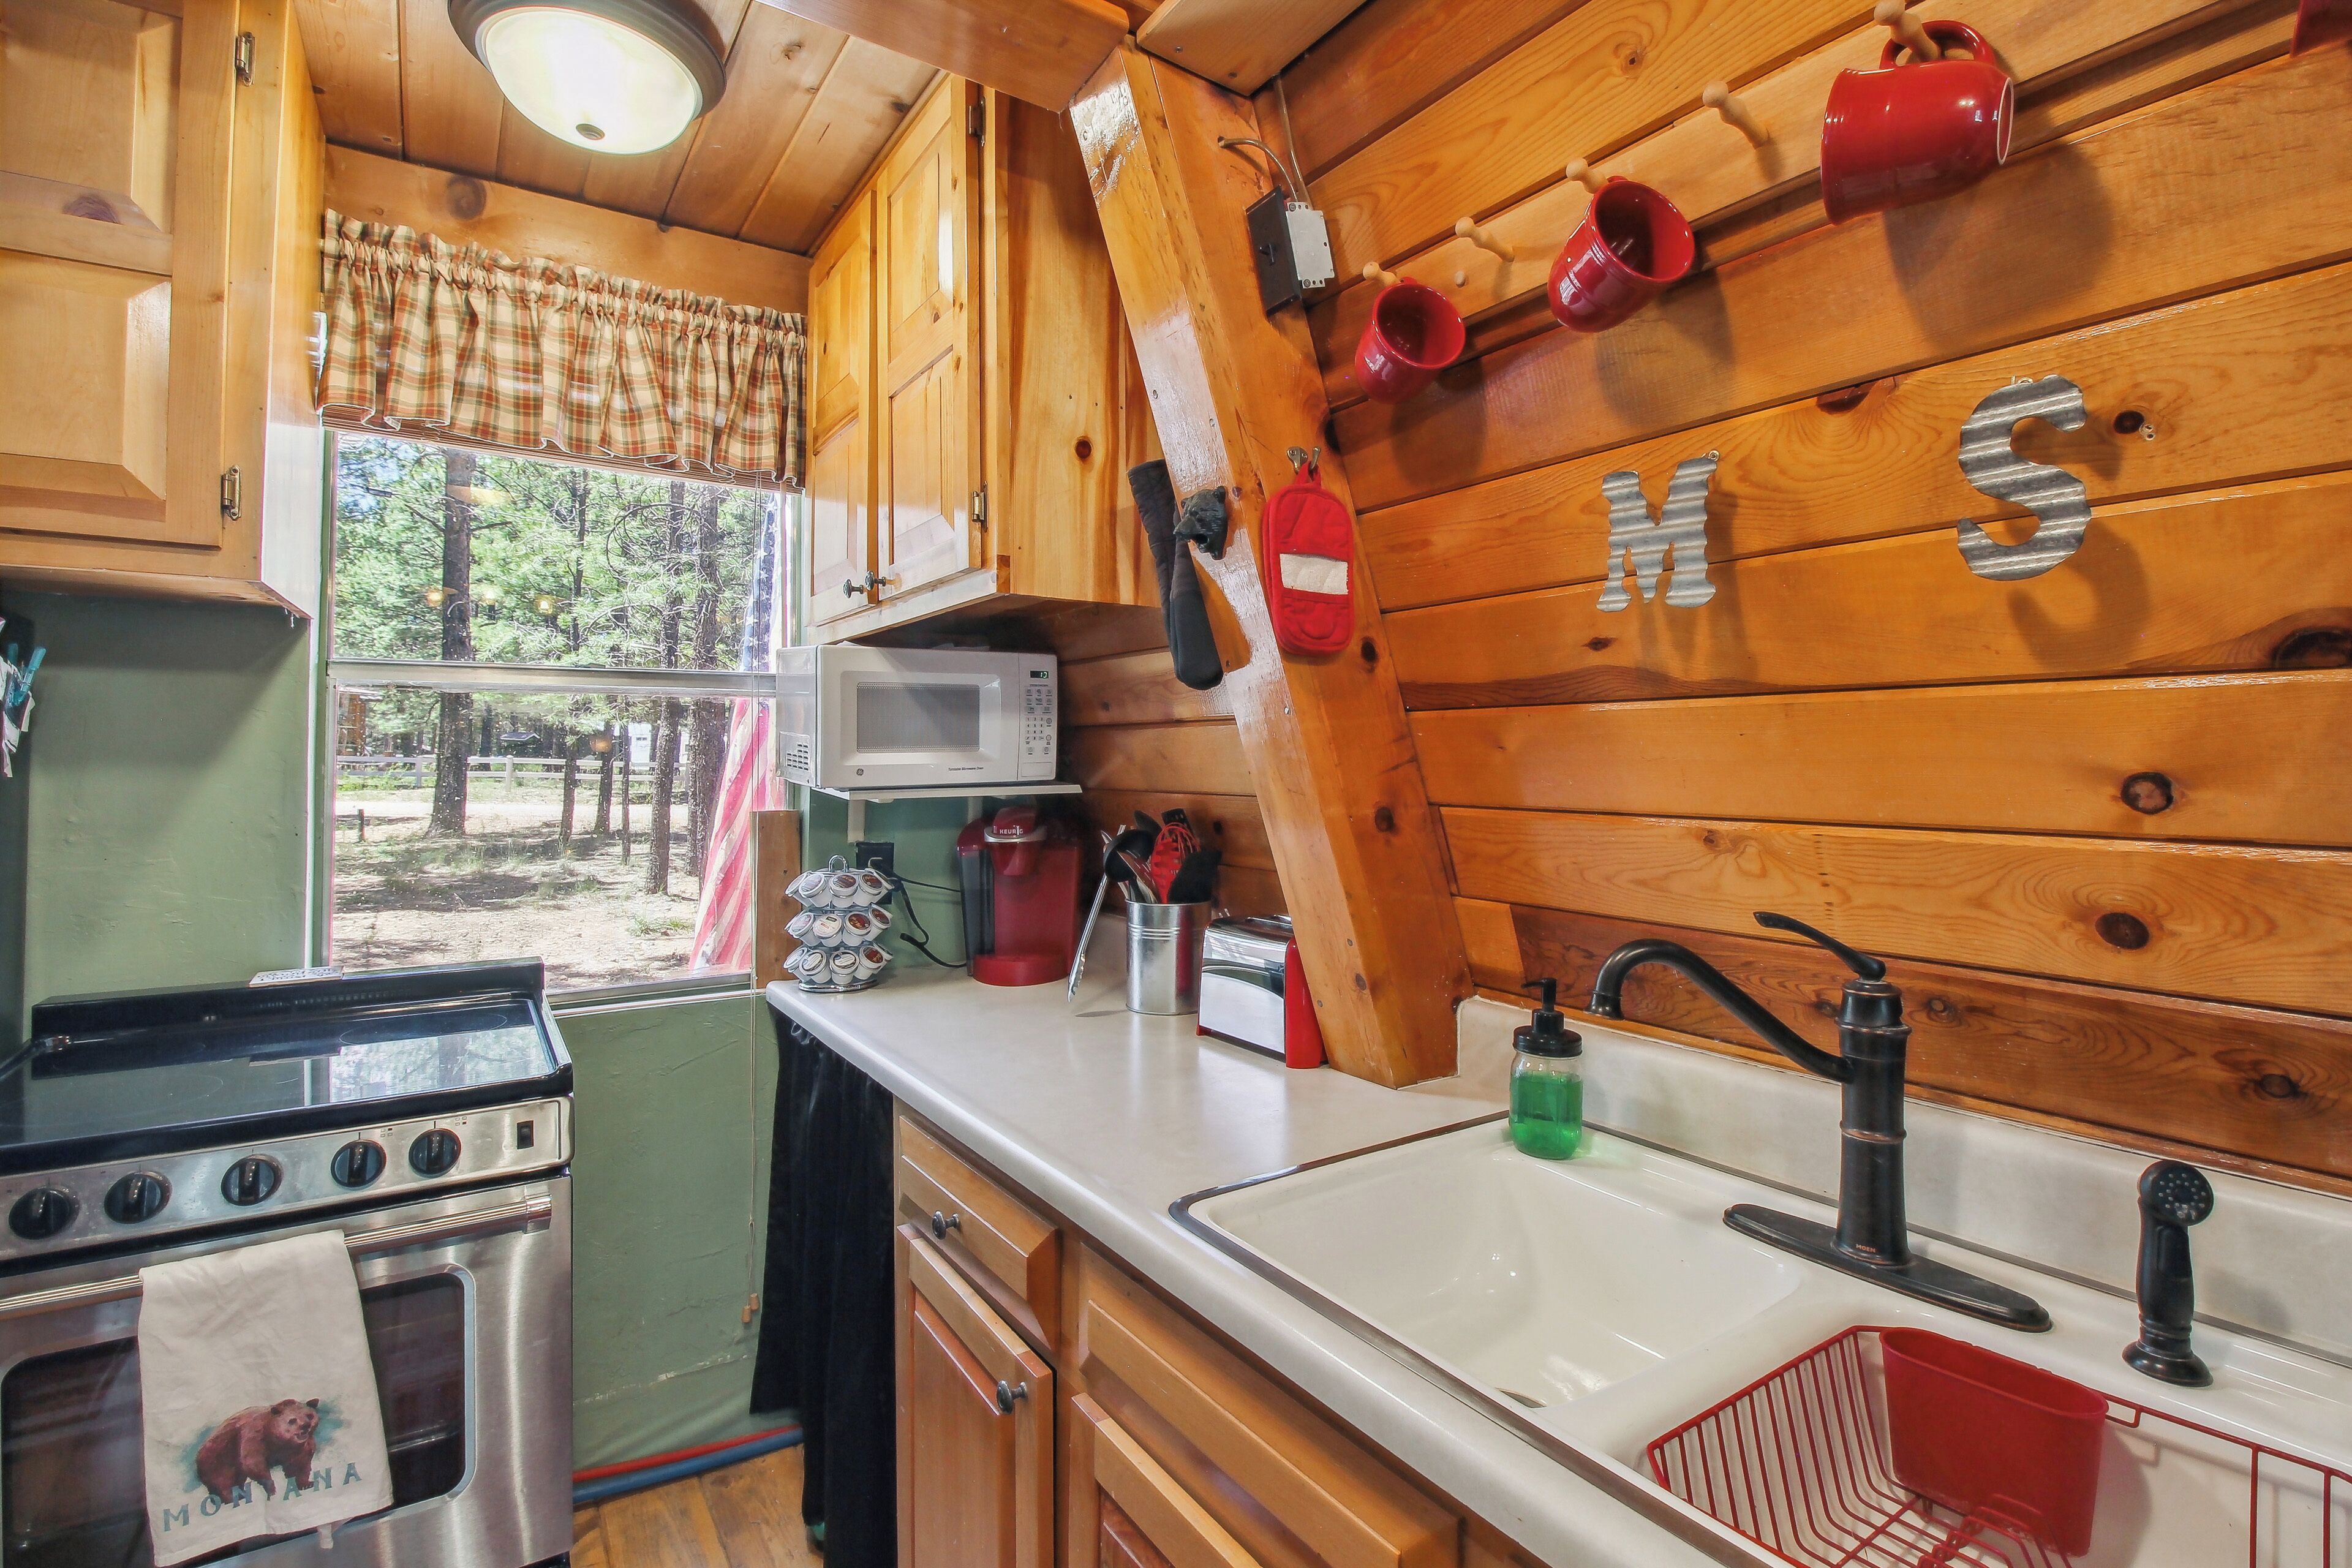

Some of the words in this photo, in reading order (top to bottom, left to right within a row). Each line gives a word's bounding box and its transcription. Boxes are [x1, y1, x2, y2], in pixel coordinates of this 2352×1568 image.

[1957, 374, 2092, 581] S
[1596, 457, 1717, 612] M
[1000, 826, 1023, 835] KEURIG
[1856, 1243, 1876, 1253] MOEN
